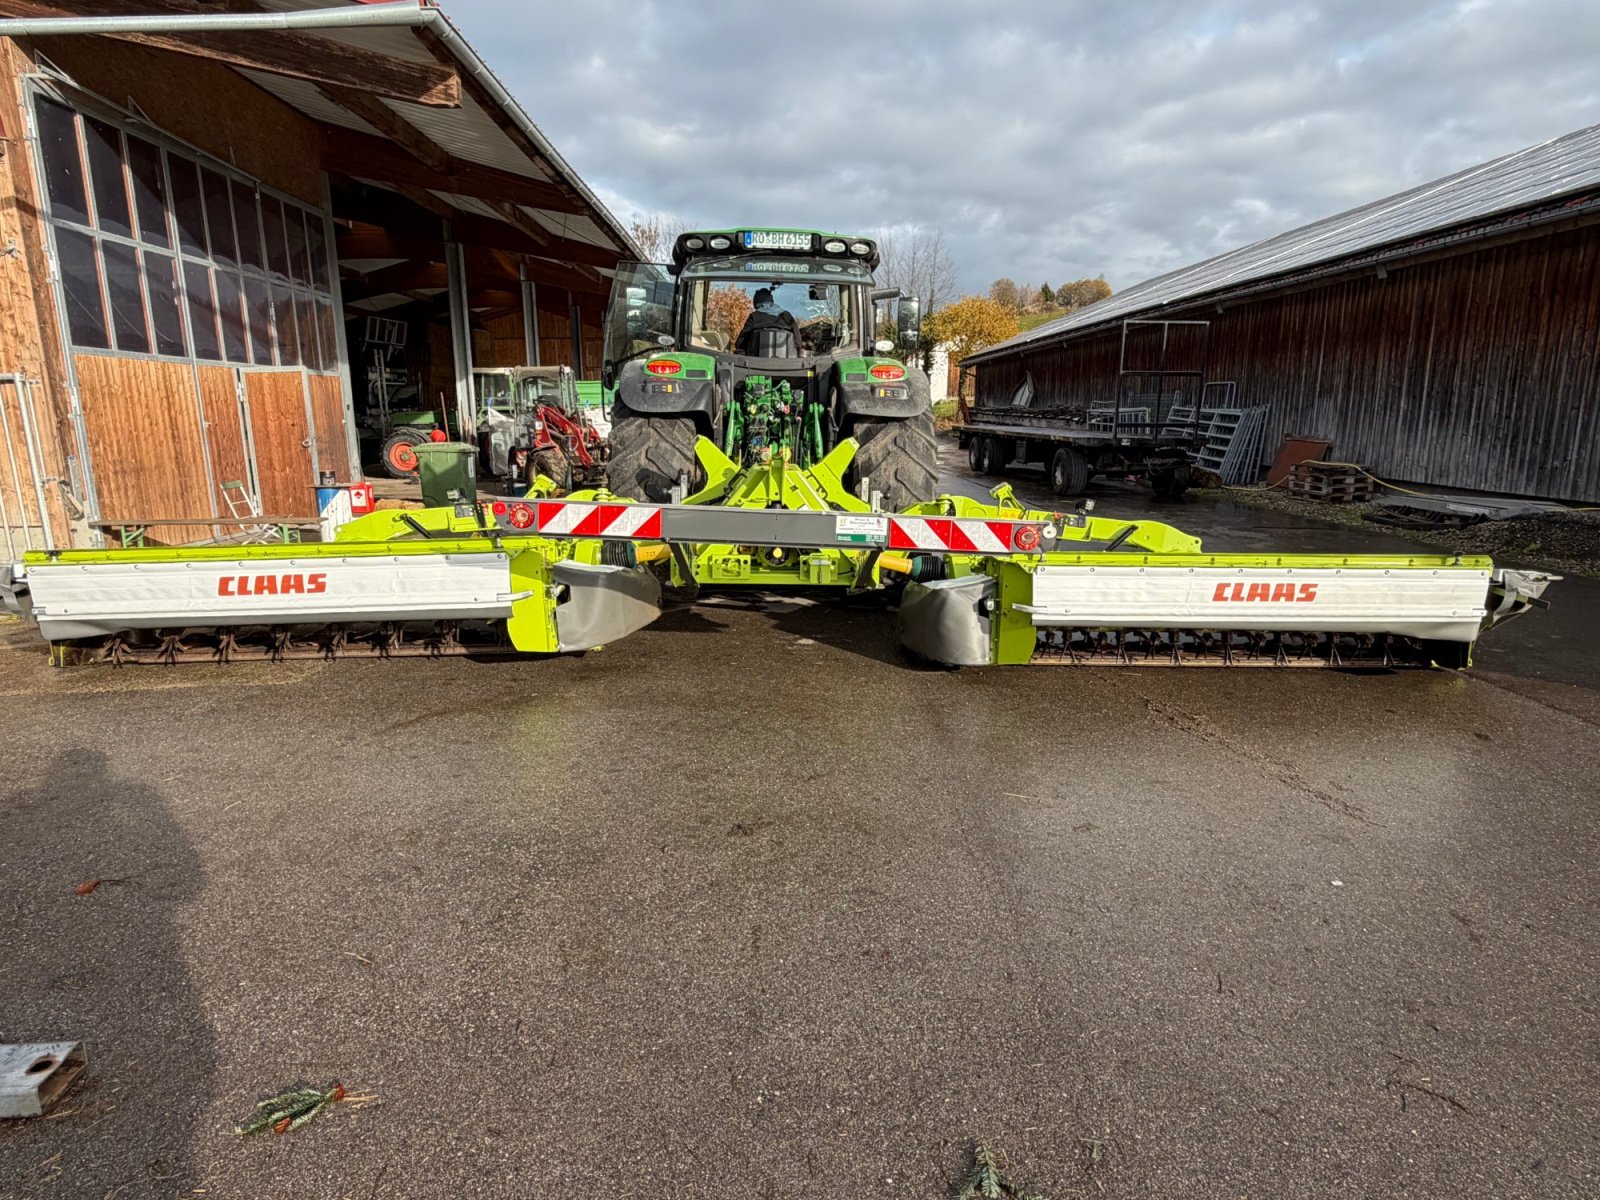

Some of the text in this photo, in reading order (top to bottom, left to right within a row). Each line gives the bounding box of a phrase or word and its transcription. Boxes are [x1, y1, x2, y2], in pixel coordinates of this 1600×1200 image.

[752, 232, 810, 246] RO BH 6155
[218, 573, 327, 597] CLAAS
[1212, 583, 1319, 602] CLAAS
